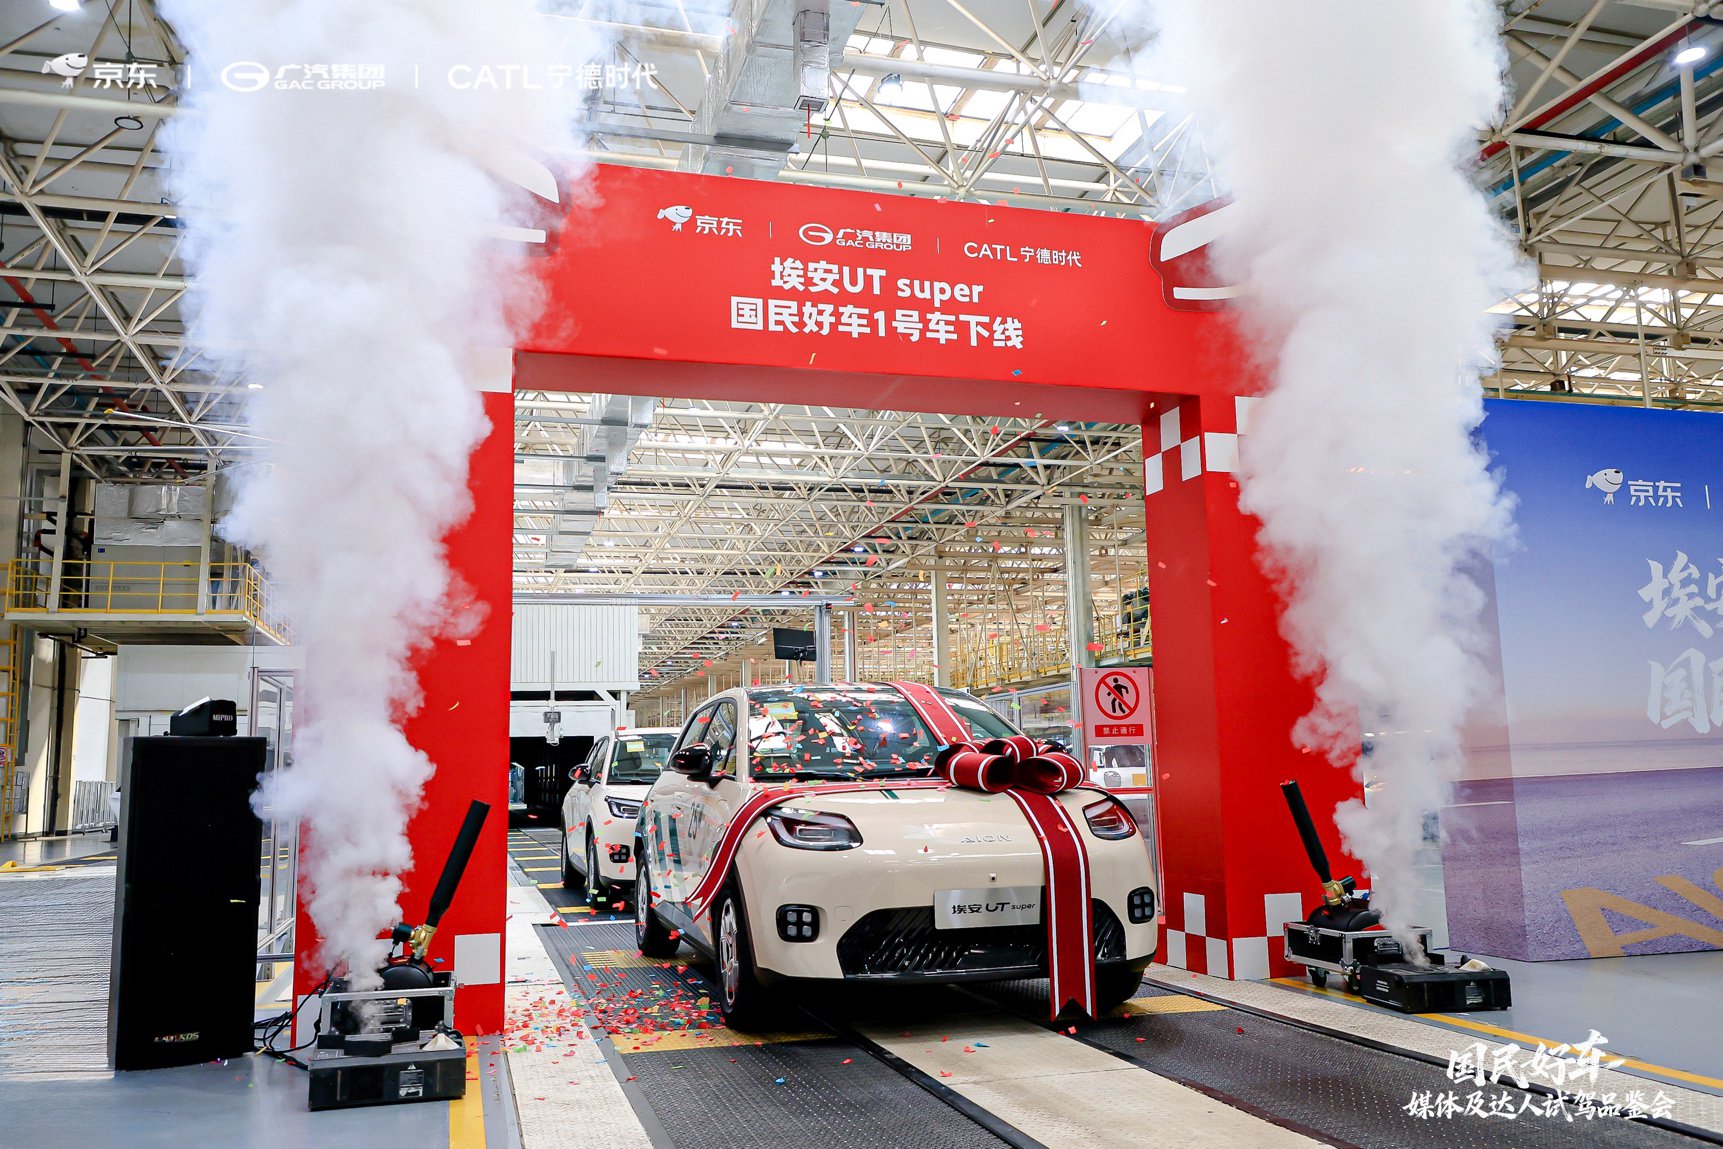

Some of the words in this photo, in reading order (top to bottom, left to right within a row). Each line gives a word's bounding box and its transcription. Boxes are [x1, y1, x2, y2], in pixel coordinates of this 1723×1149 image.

[695, 215, 743, 238] 京东
[836, 228, 912, 245] 广汽集团
[836, 239, 864, 248] GAC
[866, 241, 912, 252] GROUP
[770, 257, 886, 296] 埃安UT
[896, 276, 984, 304] super
[730, 296, 1025, 350] 国民好车1号车下线
[1628, 480, 1684, 508] 京东
[1637, 550, 1723, 640] 埃
[1646, 647, 1723, 735] 国
[1102, 726, 1136, 735] 禁止通行
[961, 834, 1012, 844] AION
[1011, 902, 1036, 911] super
